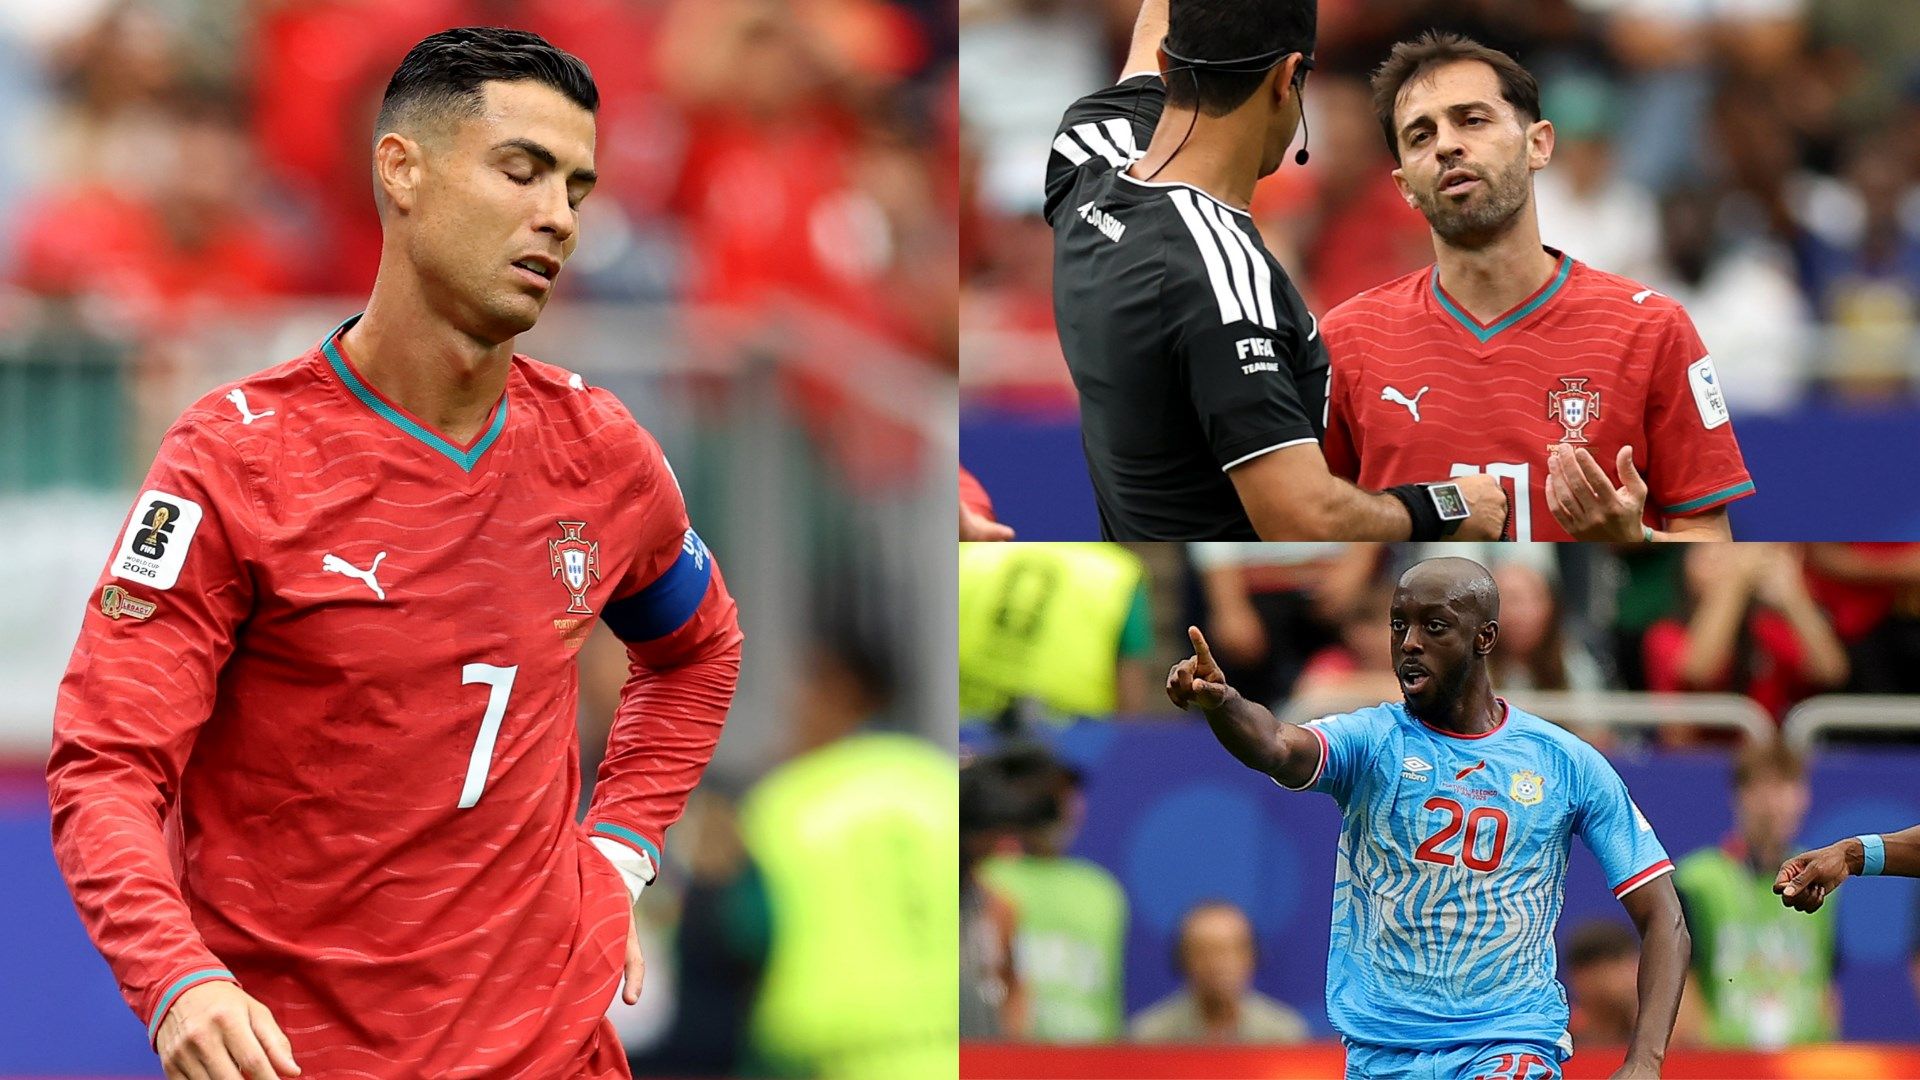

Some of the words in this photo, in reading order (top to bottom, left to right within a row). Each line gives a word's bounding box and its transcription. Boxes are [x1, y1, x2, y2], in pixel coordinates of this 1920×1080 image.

[1077, 201, 1095, 219] A
[1236, 337, 1275, 360] FIFA
[1241, 362, 1266, 375] TEAM
[140, 544, 156, 556] FIFA
[123, 562, 157, 578] 2026
[126, 556, 148, 566] WORLD
[147, 562, 160, 570] CUP
[457, 662, 519, 809] 7
[1401, 770, 1428, 783] mbro
[1414, 796, 1509, 873] 20
